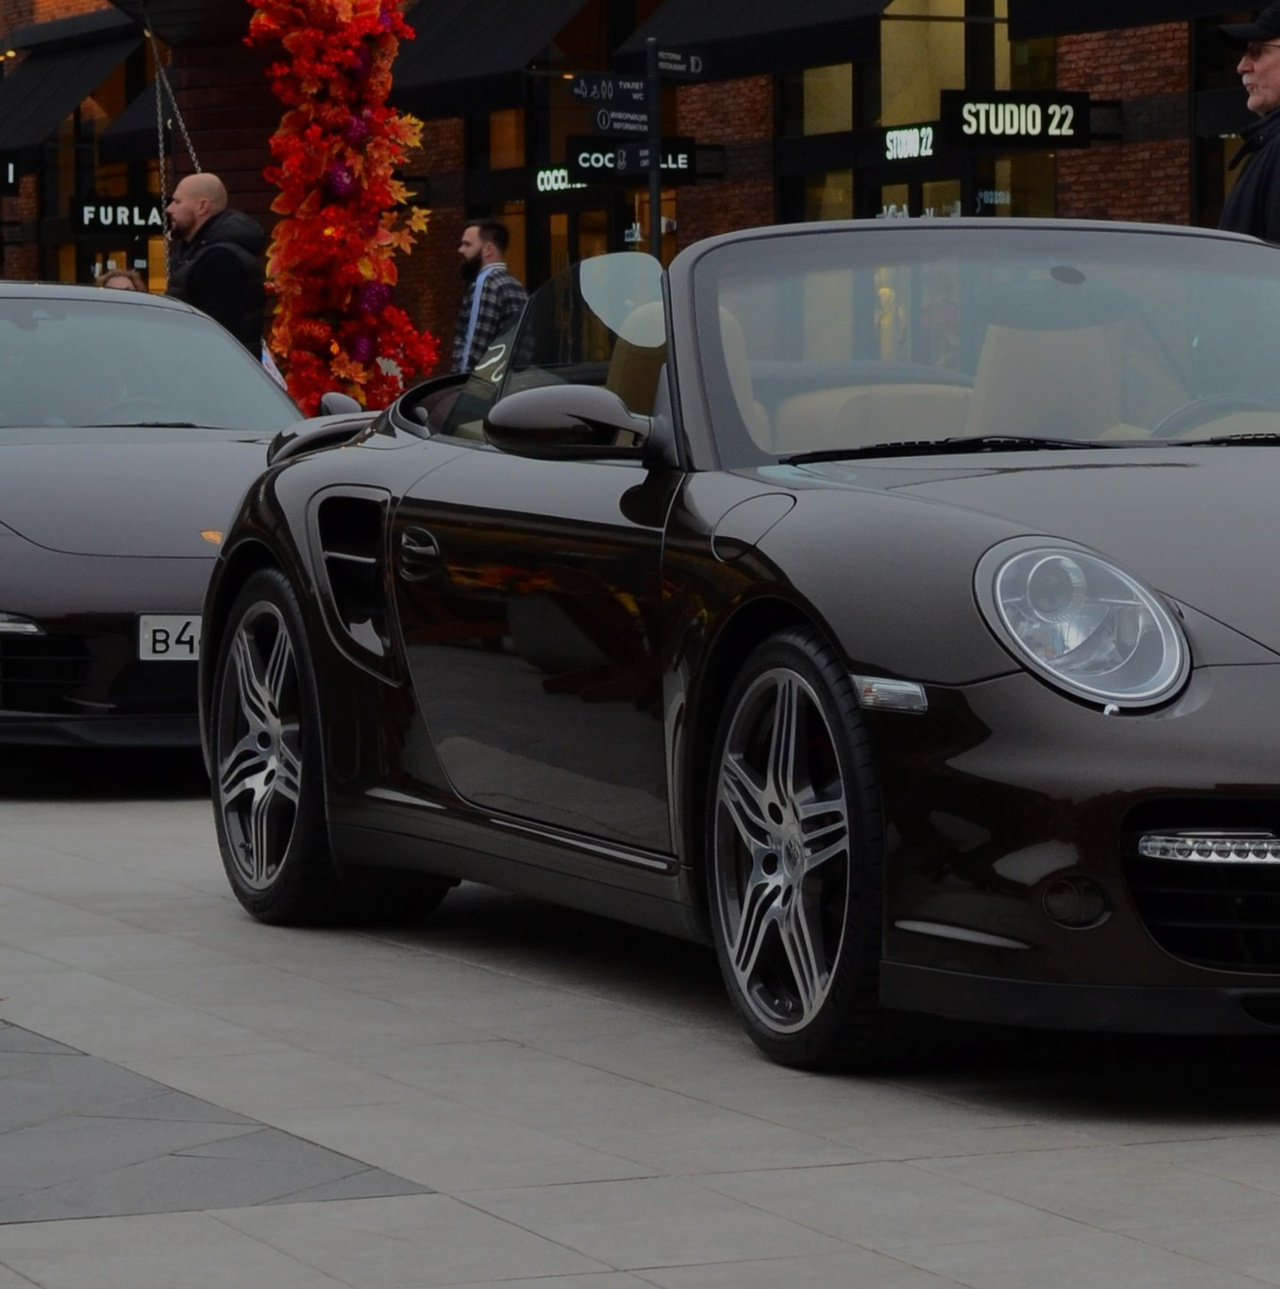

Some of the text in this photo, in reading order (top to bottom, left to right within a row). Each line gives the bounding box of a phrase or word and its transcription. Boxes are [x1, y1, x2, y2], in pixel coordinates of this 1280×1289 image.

[618, 80, 644, 91] ТУАЛЕТ
[631, 92, 645, 101] WC
[961, 102, 1075, 137] STUDIO 22
[885, 125, 934, 161] STUDIO 22
[82, 205, 163, 227] FURLA
